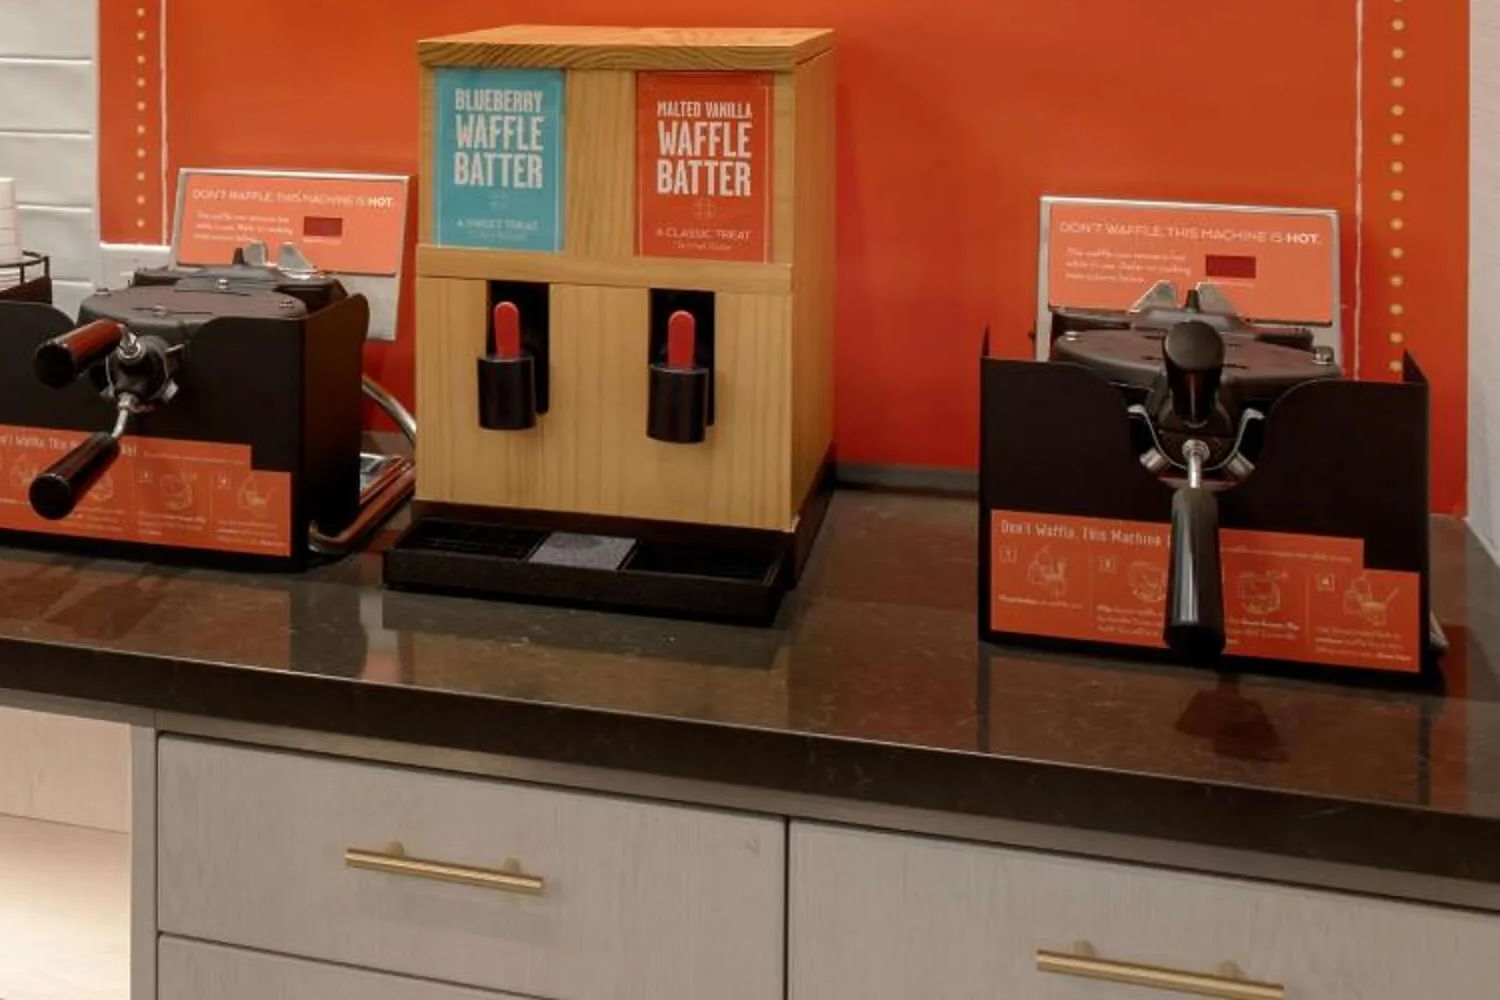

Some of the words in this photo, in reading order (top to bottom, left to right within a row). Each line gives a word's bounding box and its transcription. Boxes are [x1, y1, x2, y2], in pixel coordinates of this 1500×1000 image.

[455, 88, 544, 114] BLUEBERRY
[657, 101, 701, 118] MALTED
[705, 102, 753, 119] VANILLA
[455, 114, 545, 152] WAFFLE
[657, 121, 753, 159] WAFFLE
[454, 151, 544, 188] BATTER
[656, 159, 752, 197] BATTER
[716, 229, 752, 241] TREAT
[1059, 220, 1104, 234] DON'T
[1167, 226, 1200, 240] THIS
[1201, 228, 1267, 242] MACHINE
